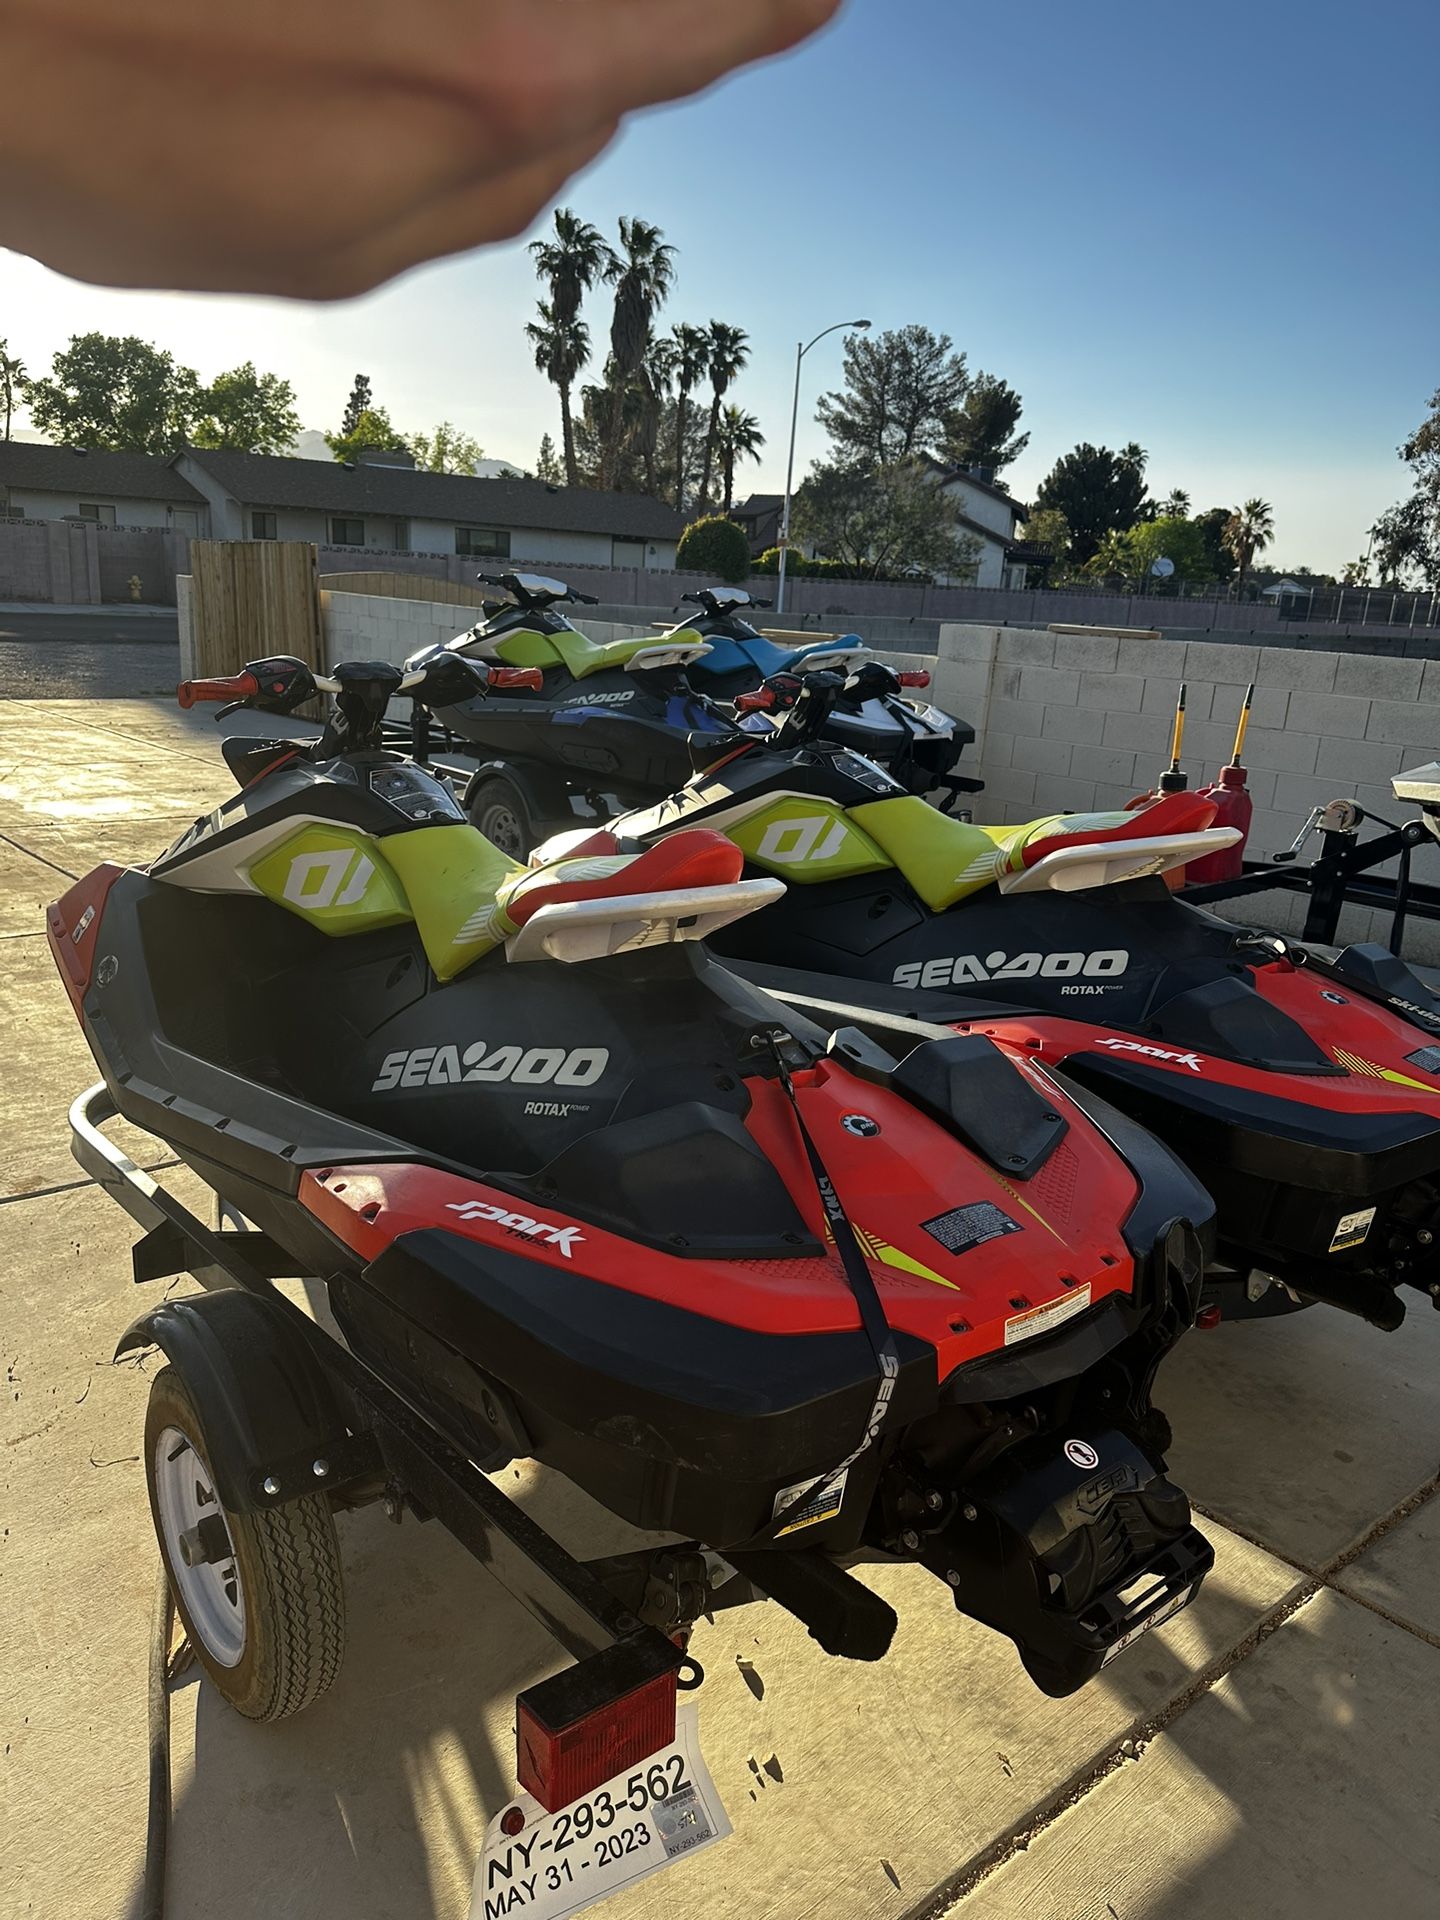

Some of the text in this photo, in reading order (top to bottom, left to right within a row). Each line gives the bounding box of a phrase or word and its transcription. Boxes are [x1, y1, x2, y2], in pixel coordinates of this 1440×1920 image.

[1061, 985, 1105, 996] ROTAX
[524, 1101, 570, 1117] ROTAX
[488, 1754, 692, 1890] NY-293-562
[668, 1829, 710, 1855] NY-293-562
[485, 1873, 537, 1920] MAY
[545, 1858, 573, 1890] 31
[594, 1822, 651, 1867] 2023
